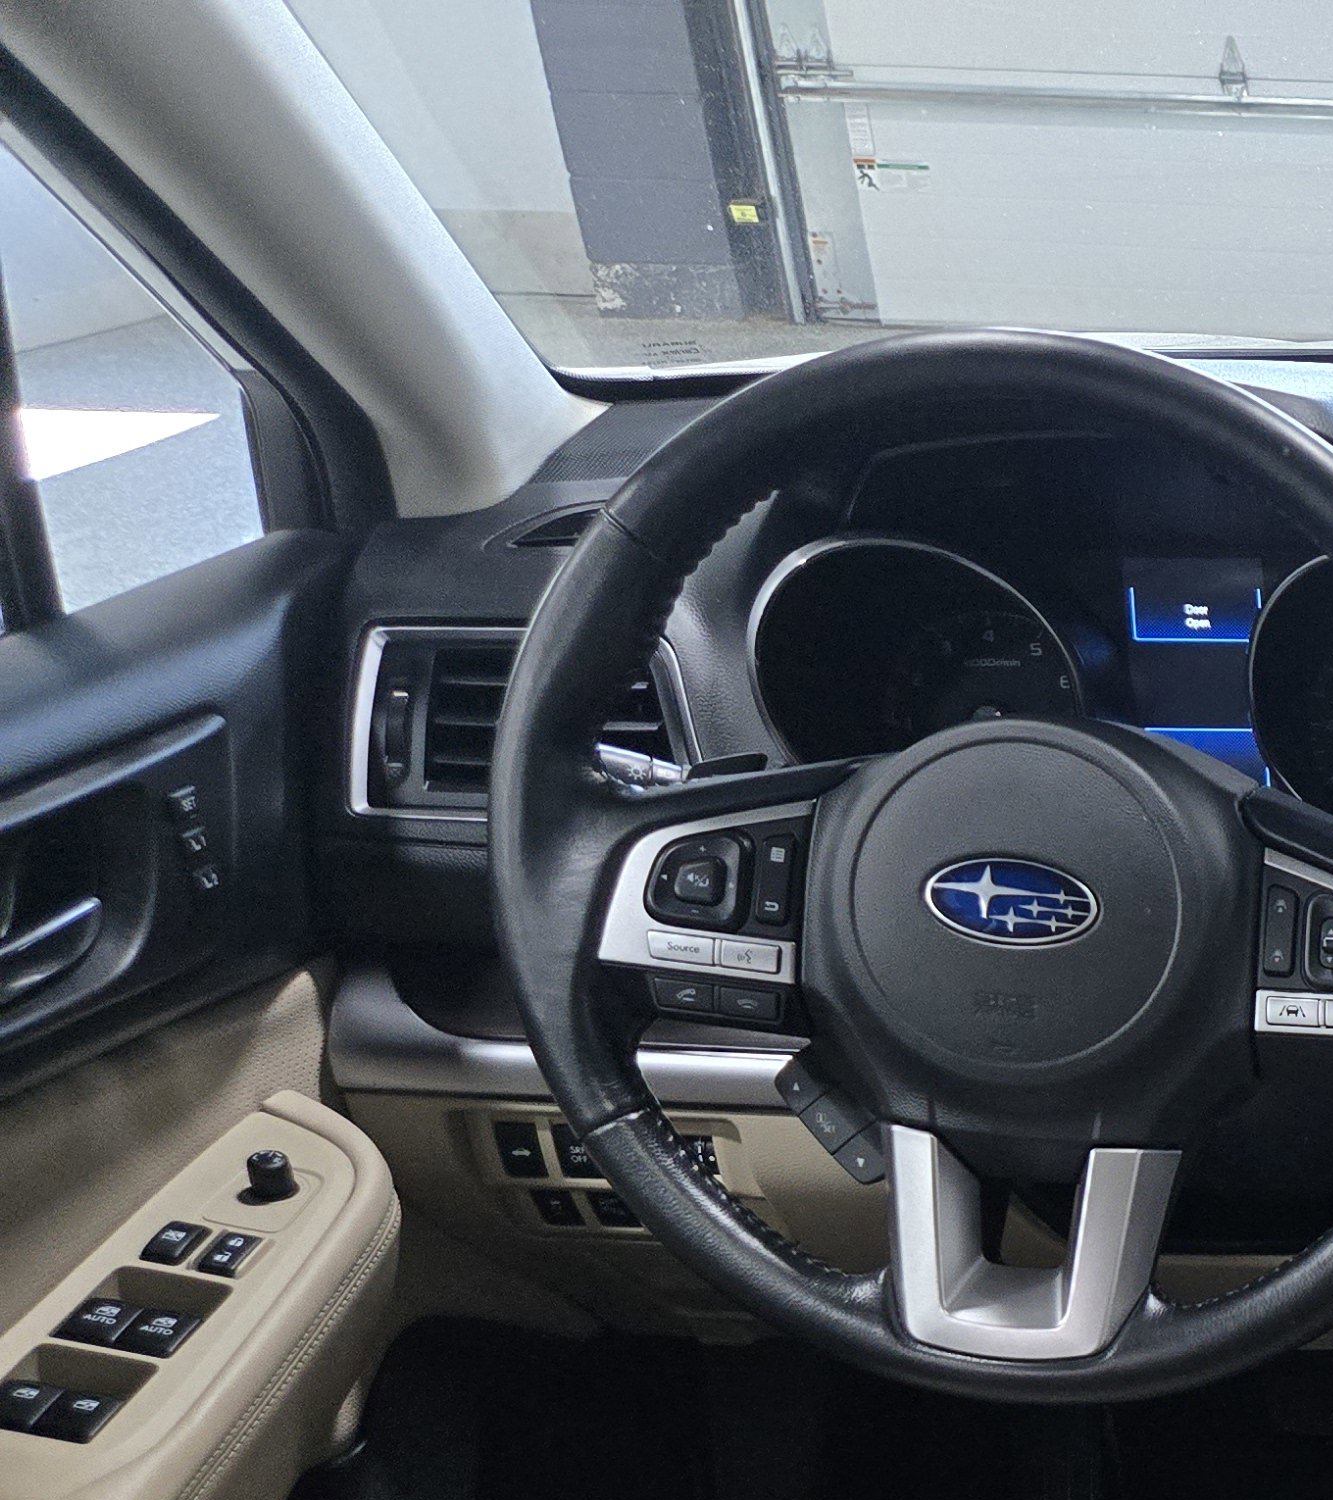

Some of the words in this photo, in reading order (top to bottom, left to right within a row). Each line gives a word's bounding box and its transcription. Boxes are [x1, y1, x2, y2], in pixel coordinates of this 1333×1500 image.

[667, 941, 700, 954] Source
[83, 1313, 117, 1325] AUTO
[139, 1325, 174, 1336] AUTO
